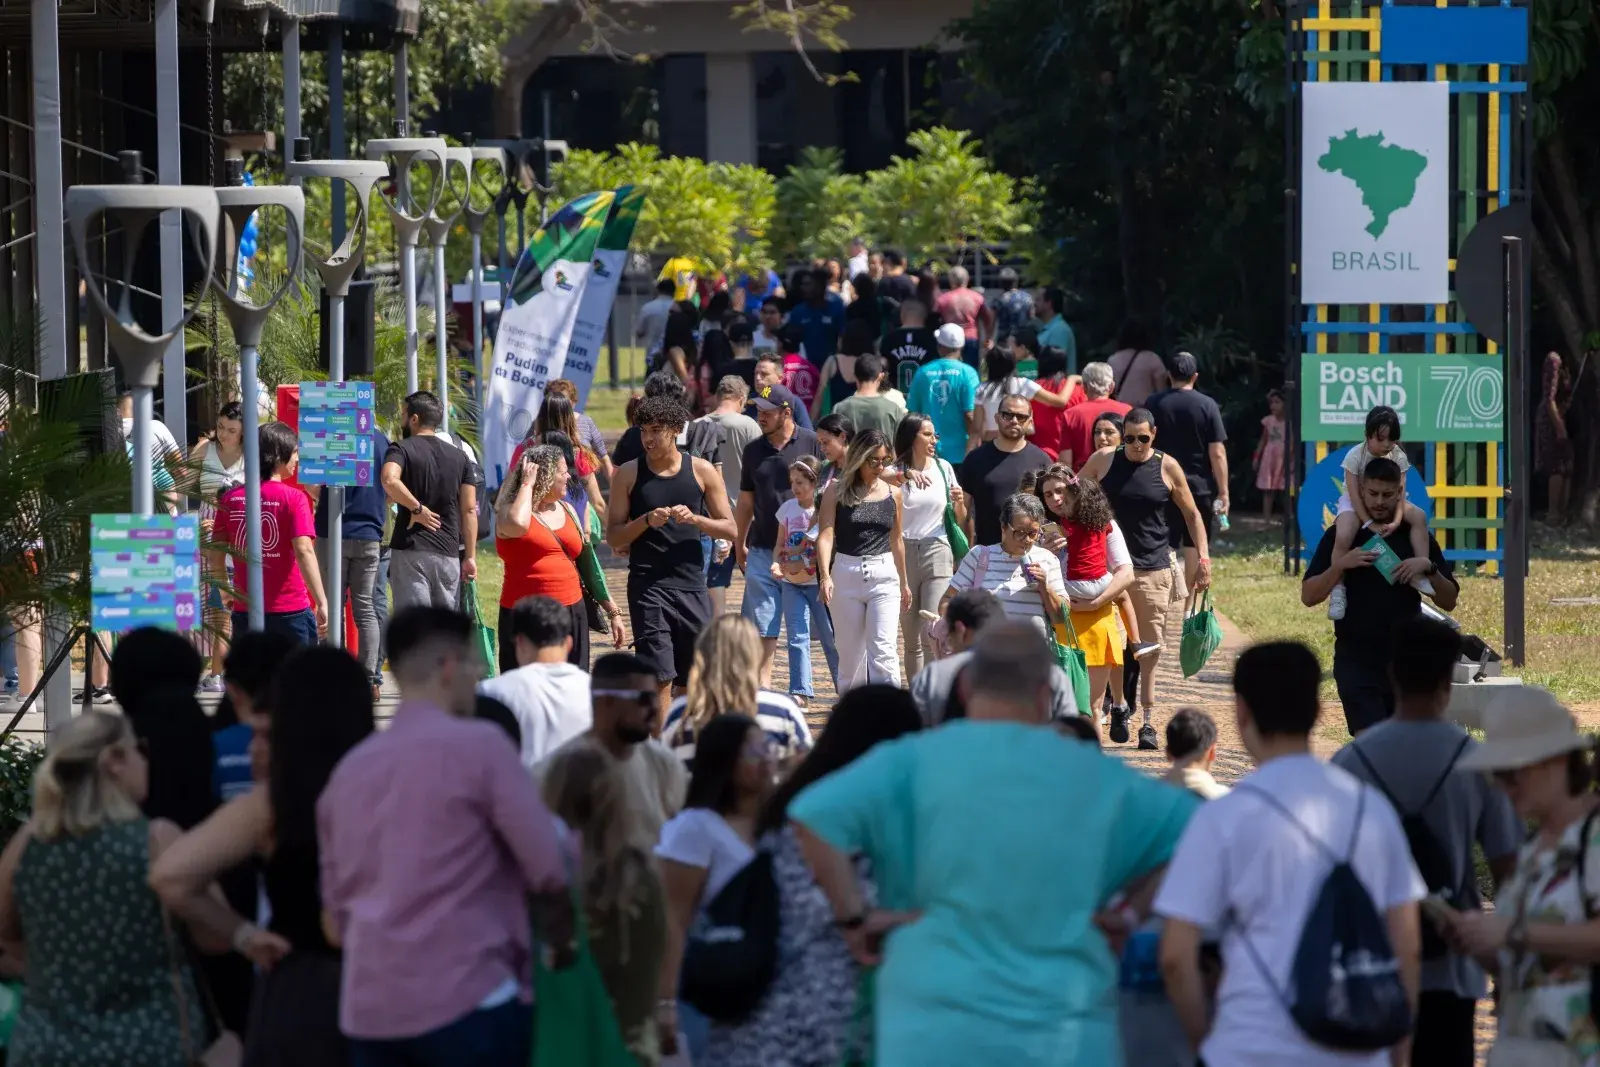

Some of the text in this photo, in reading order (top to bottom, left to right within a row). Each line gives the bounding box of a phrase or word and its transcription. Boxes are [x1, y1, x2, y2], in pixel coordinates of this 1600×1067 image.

[1332, 251, 1419, 271] BRASIL
[890, 345, 927, 360] TATUM
[505, 352, 549, 375] Pudim
[511, 369, 545, 390] Bosc
[358, 391, 370, 399] 08
[1320, 361, 1504, 428] Bosch 70
[1320, 385, 1407, 410] LAND
[176, 527, 194, 540] 05
[175, 565, 193, 578] 04
[175, 603, 194, 617] 03
